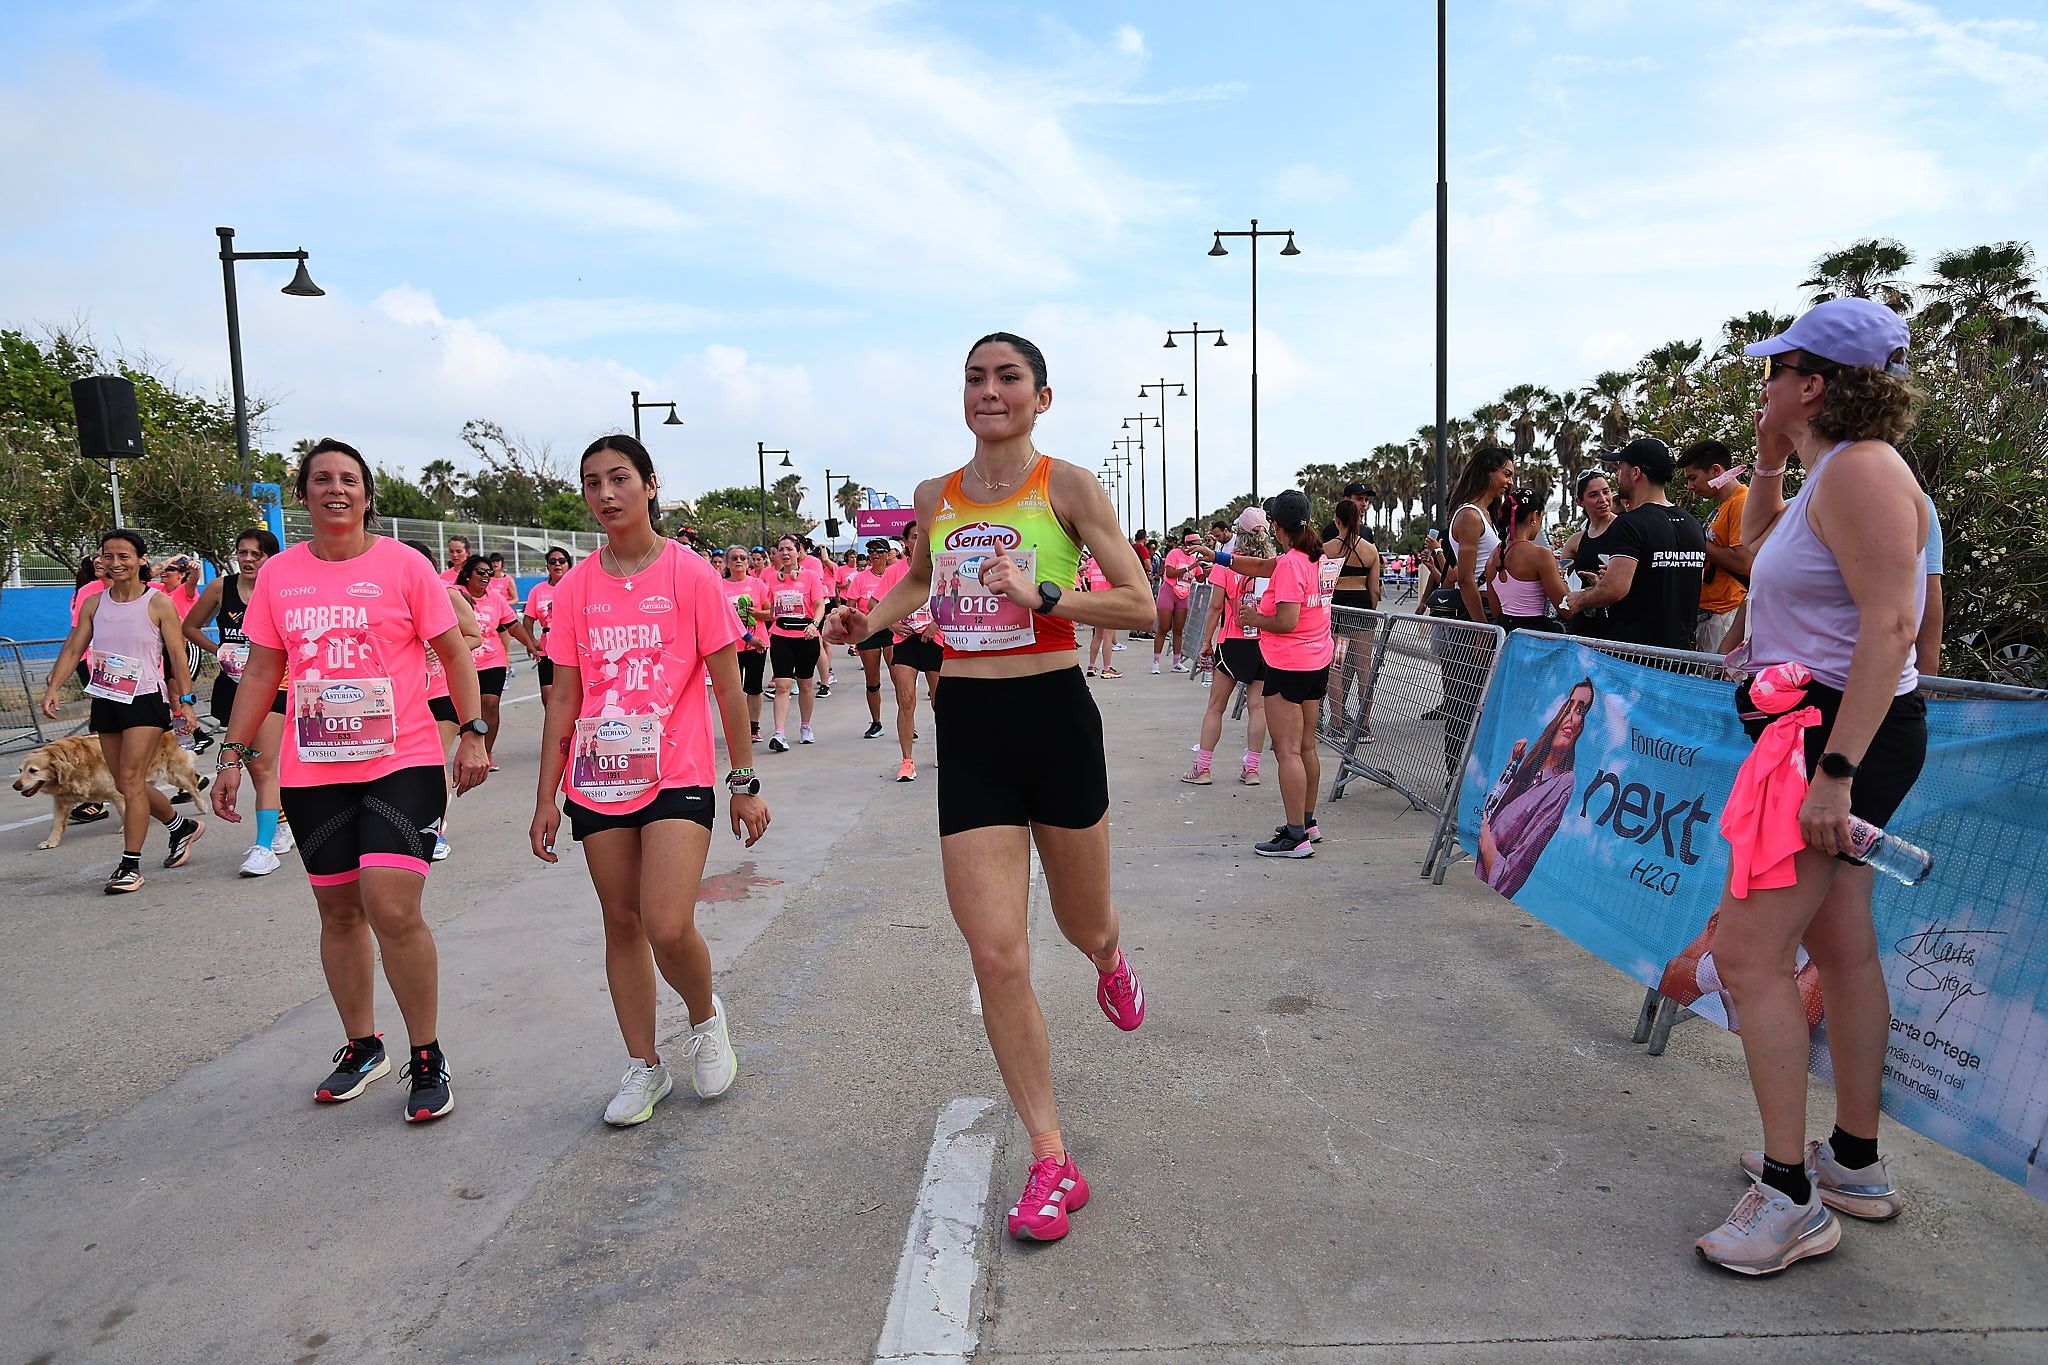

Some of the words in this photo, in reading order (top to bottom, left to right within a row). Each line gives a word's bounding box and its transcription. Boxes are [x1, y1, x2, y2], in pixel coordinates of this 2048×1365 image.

[950, 533, 1014, 548] Serrano
[280, 586, 316, 598] OYSHO
[959, 596, 999, 614] 016
[974, 616, 983, 624] 12
[988, 634, 1022, 645] Santander
[327, 638, 356, 669] DE
[103, 672, 120, 684] 016
[625, 658, 650, 691] DE
[324, 692, 362, 700] ASTURIANA
[325, 716, 363, 732] 016
[599, 729, 629, 737] ASTURIANA
[308, 750, 337, 758] OYSHO
[355, 748, 385, 756] Santander
[598, 755, 630, 770] 016
[1580, 768, 1712, 866] next
[1922, 1031, 1981, 1070] Ortega
[1909, 1054, 1943, 1080] joven
[1893, 1069, 1940, 1101] mundial
